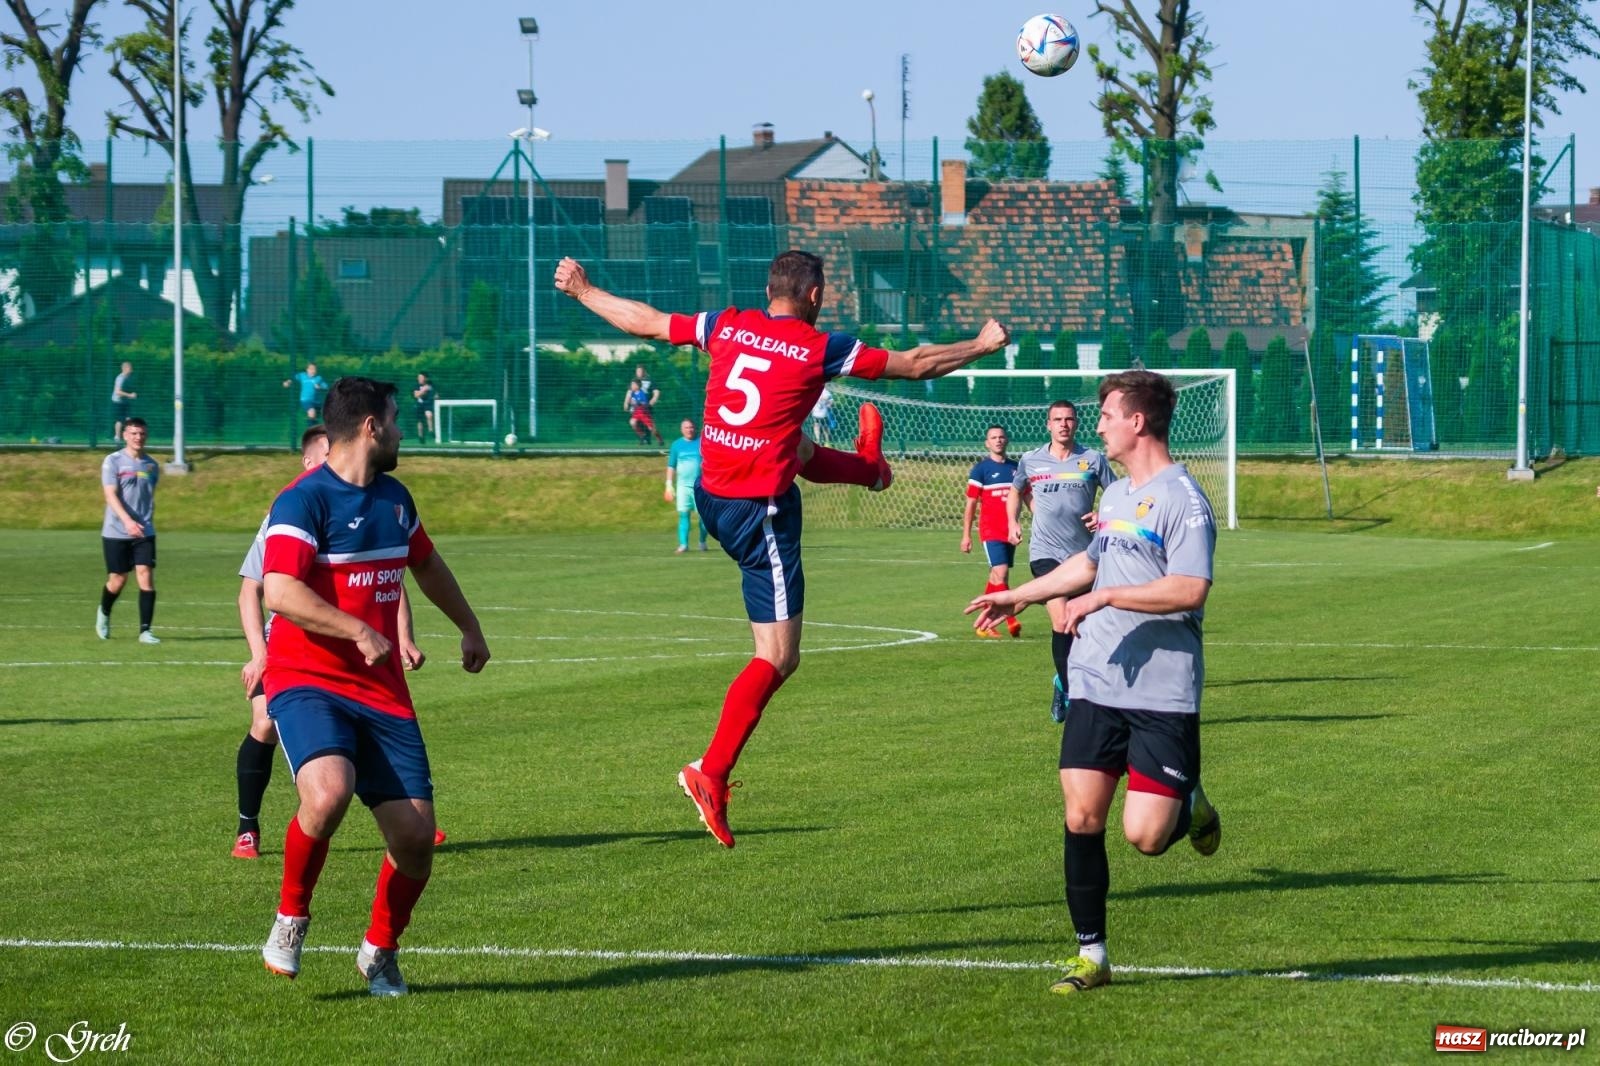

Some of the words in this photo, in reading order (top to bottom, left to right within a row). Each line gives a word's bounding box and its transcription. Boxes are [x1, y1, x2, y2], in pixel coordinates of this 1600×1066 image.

[733, 328, 811, 362] KOLEJARZ
[717, 352, 772, 426] 5
[704, 424, 771, 452] CHAŁUPK
[348, 571, 375, 587] MW
